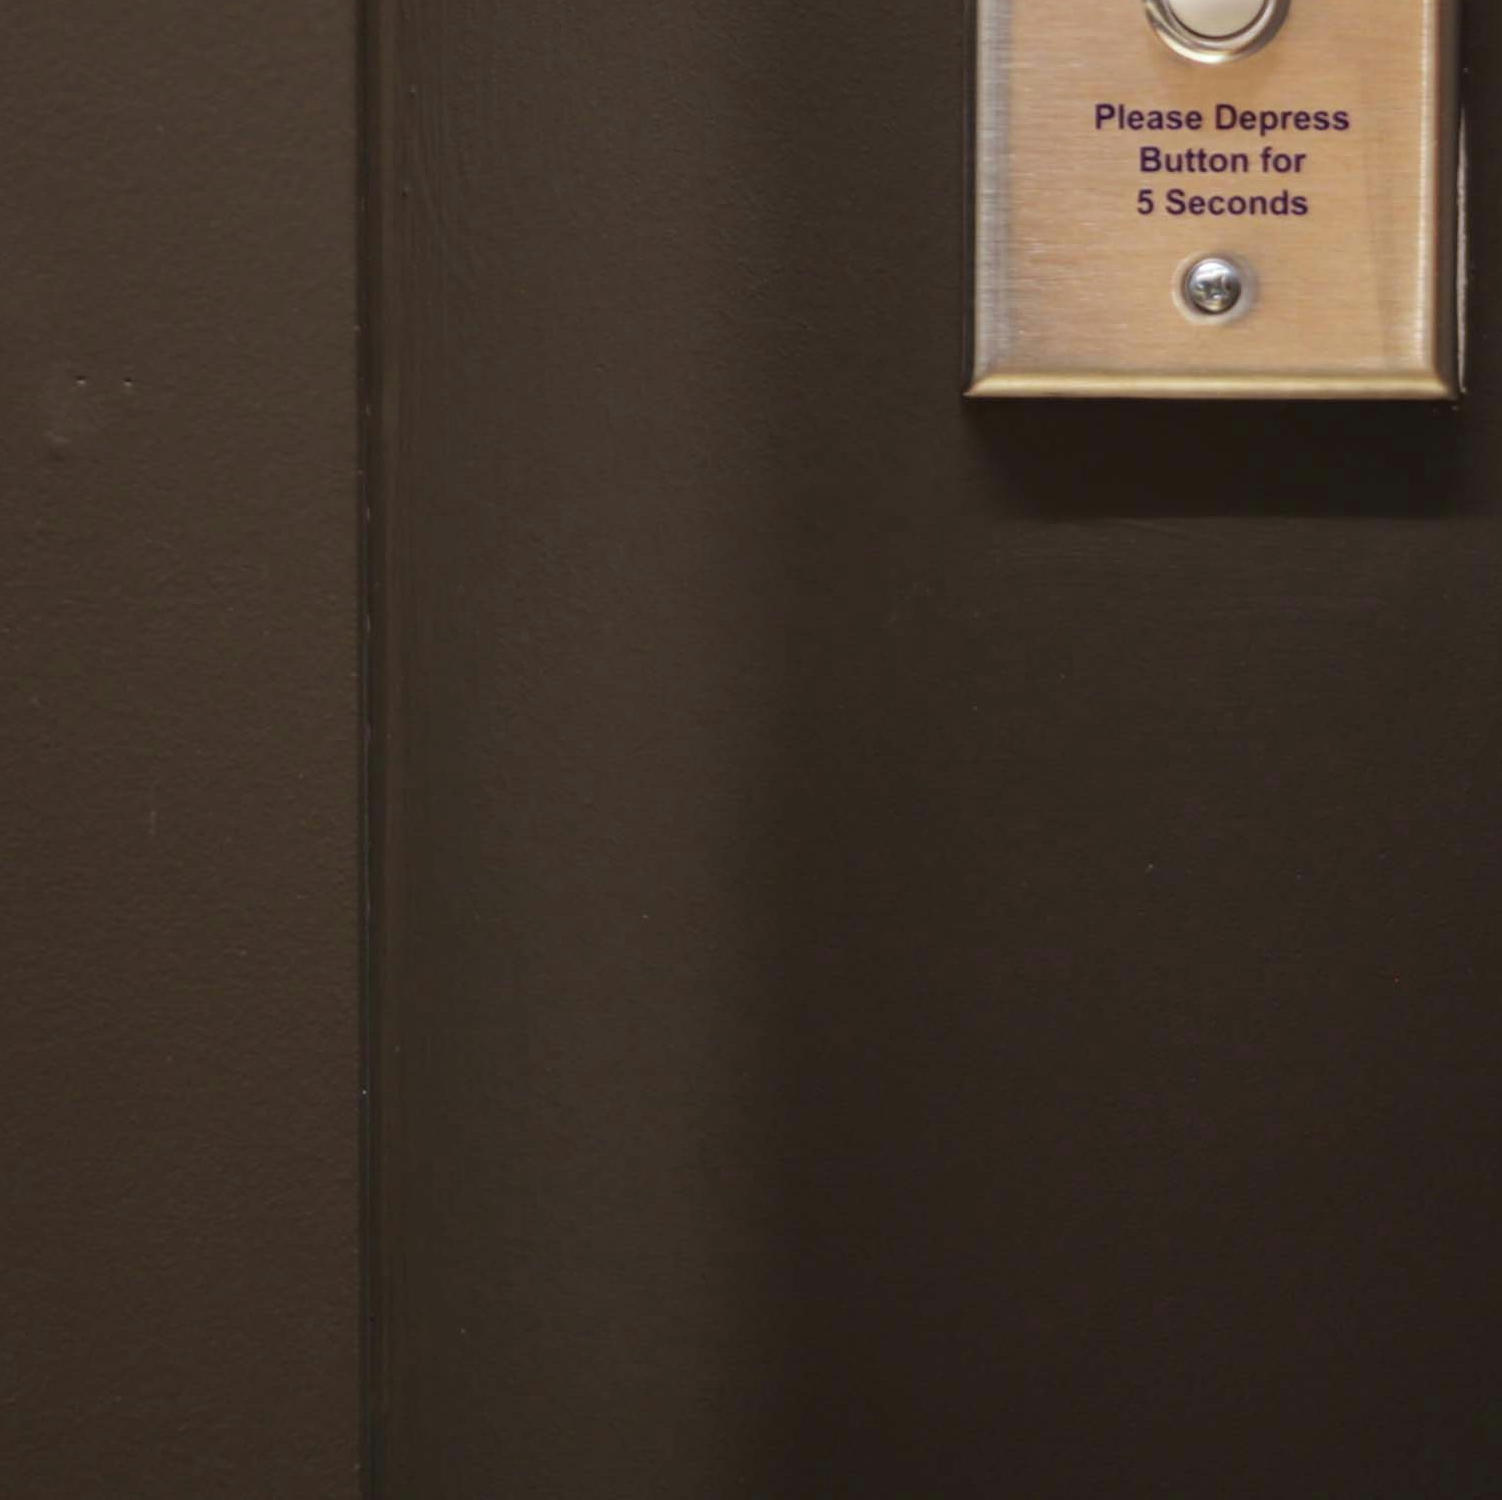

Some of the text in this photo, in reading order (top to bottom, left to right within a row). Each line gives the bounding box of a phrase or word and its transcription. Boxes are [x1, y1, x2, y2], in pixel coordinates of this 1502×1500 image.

[1095, 104, 1351, 138] Please Depress
[1139, 146, 1307, 173] Button for
[1136, 188, 1309, 216] 5 Seconds
